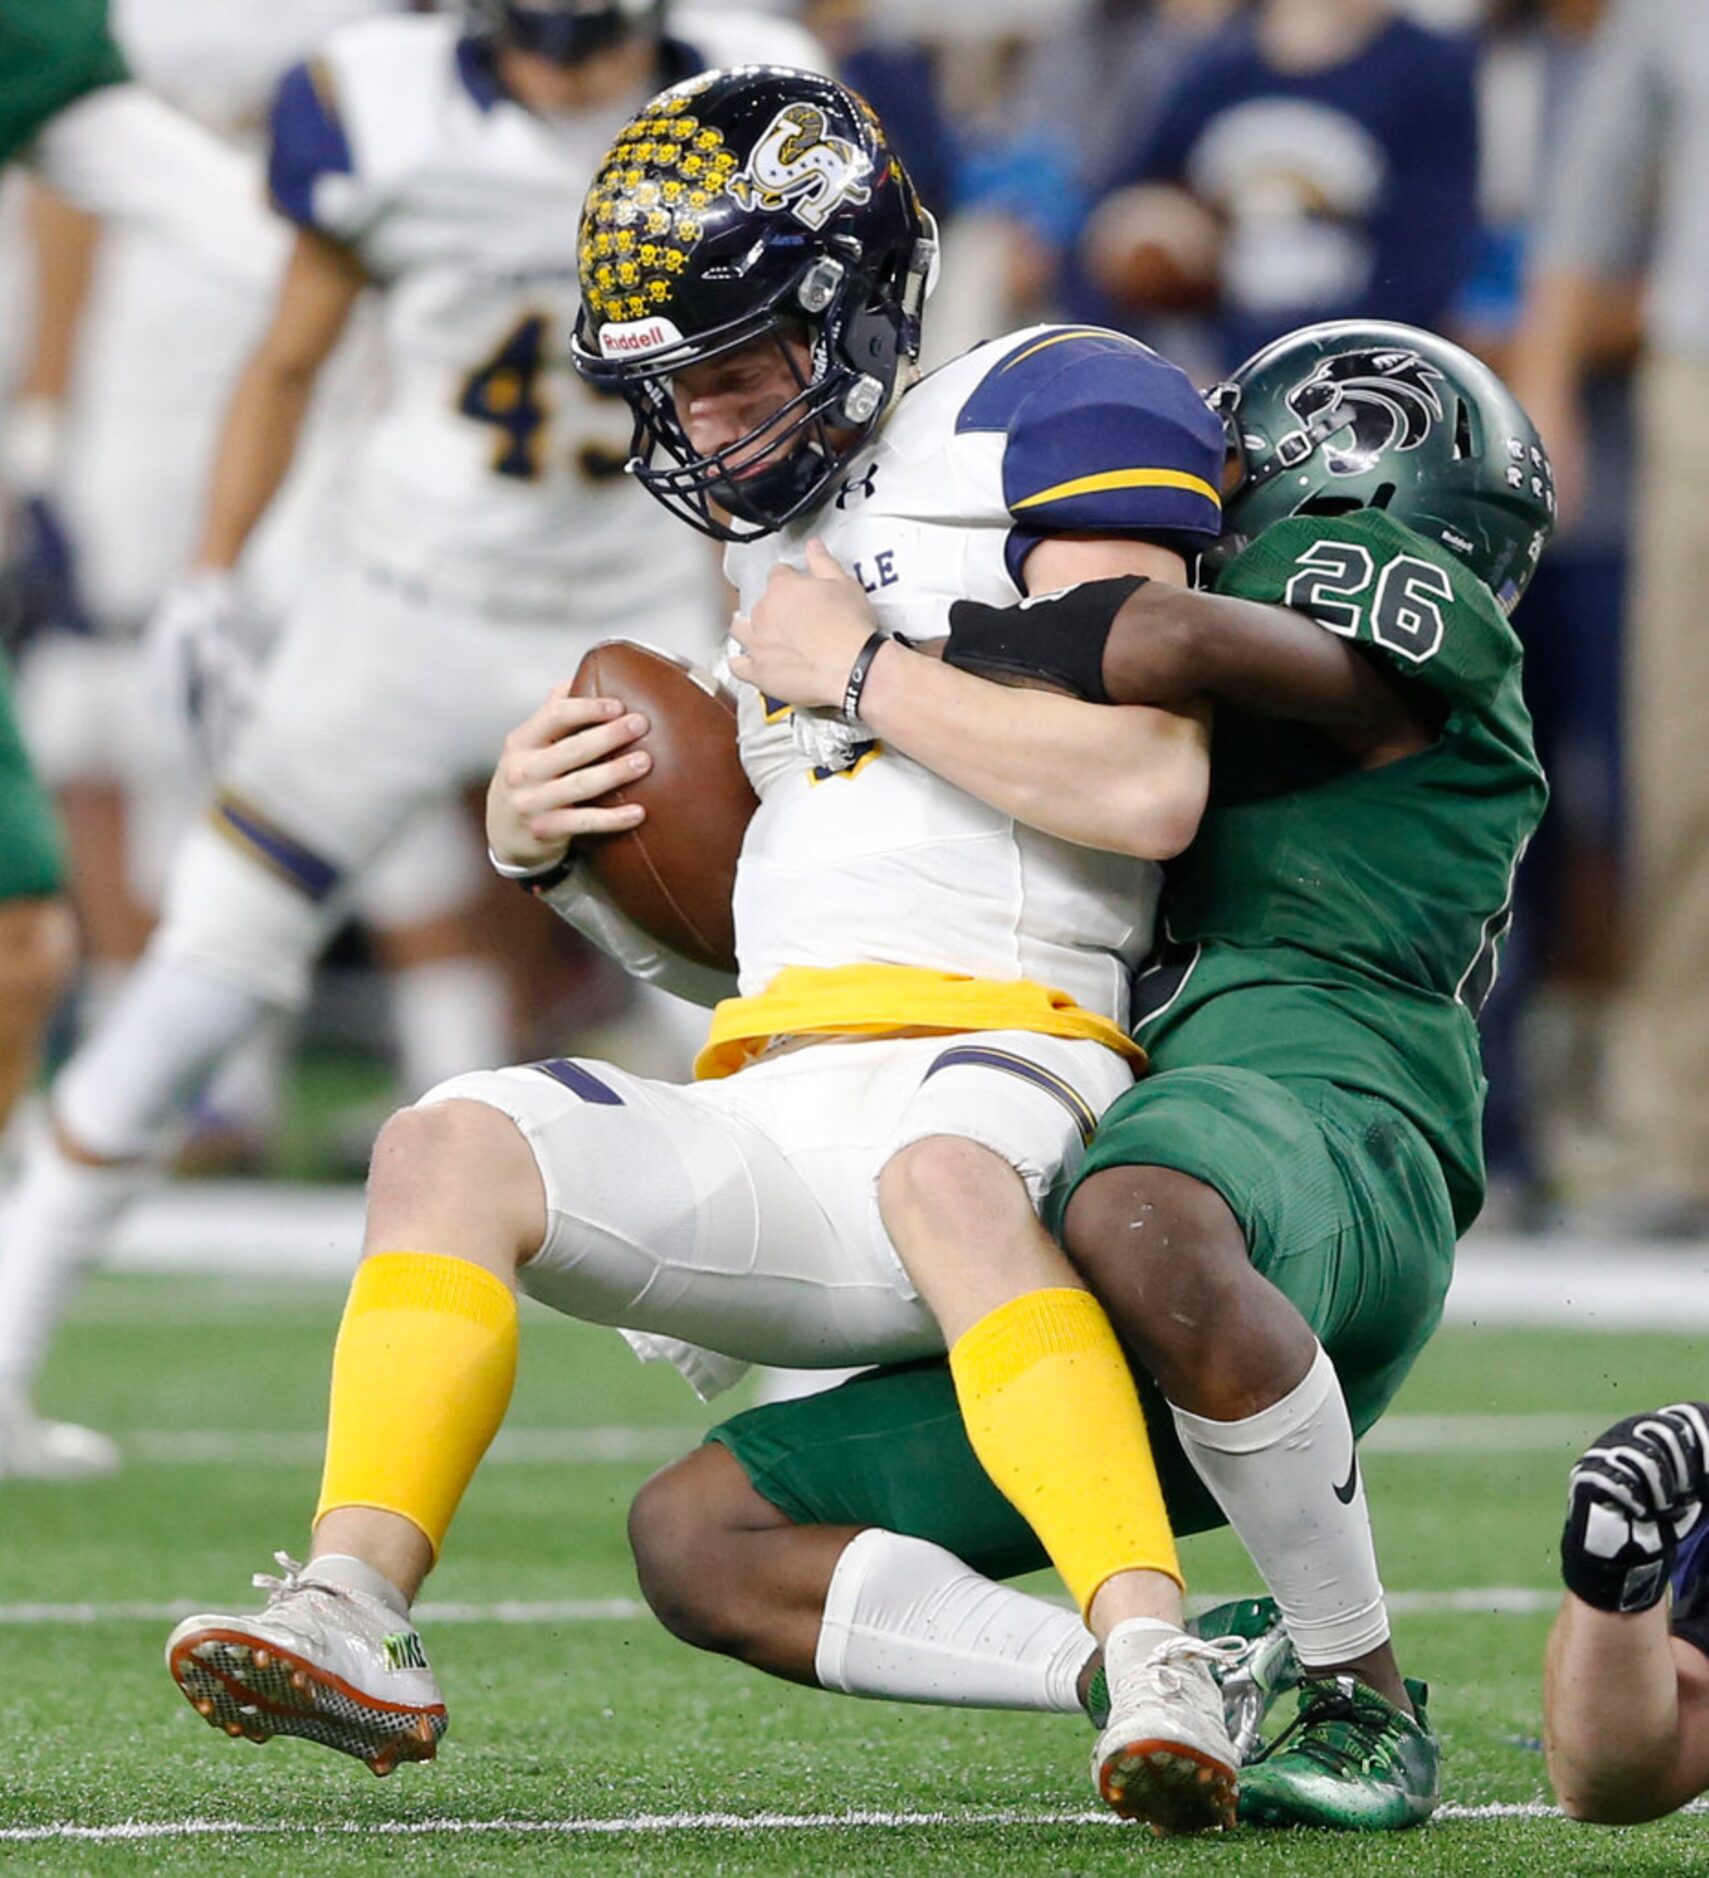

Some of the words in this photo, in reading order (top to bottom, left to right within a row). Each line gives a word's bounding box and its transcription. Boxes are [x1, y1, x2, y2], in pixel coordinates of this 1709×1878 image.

[602, 326, 665, 352] Riddell
[1285, 540, 1454, 662] 26
[383, 1632, 428, 1671] NIKE
